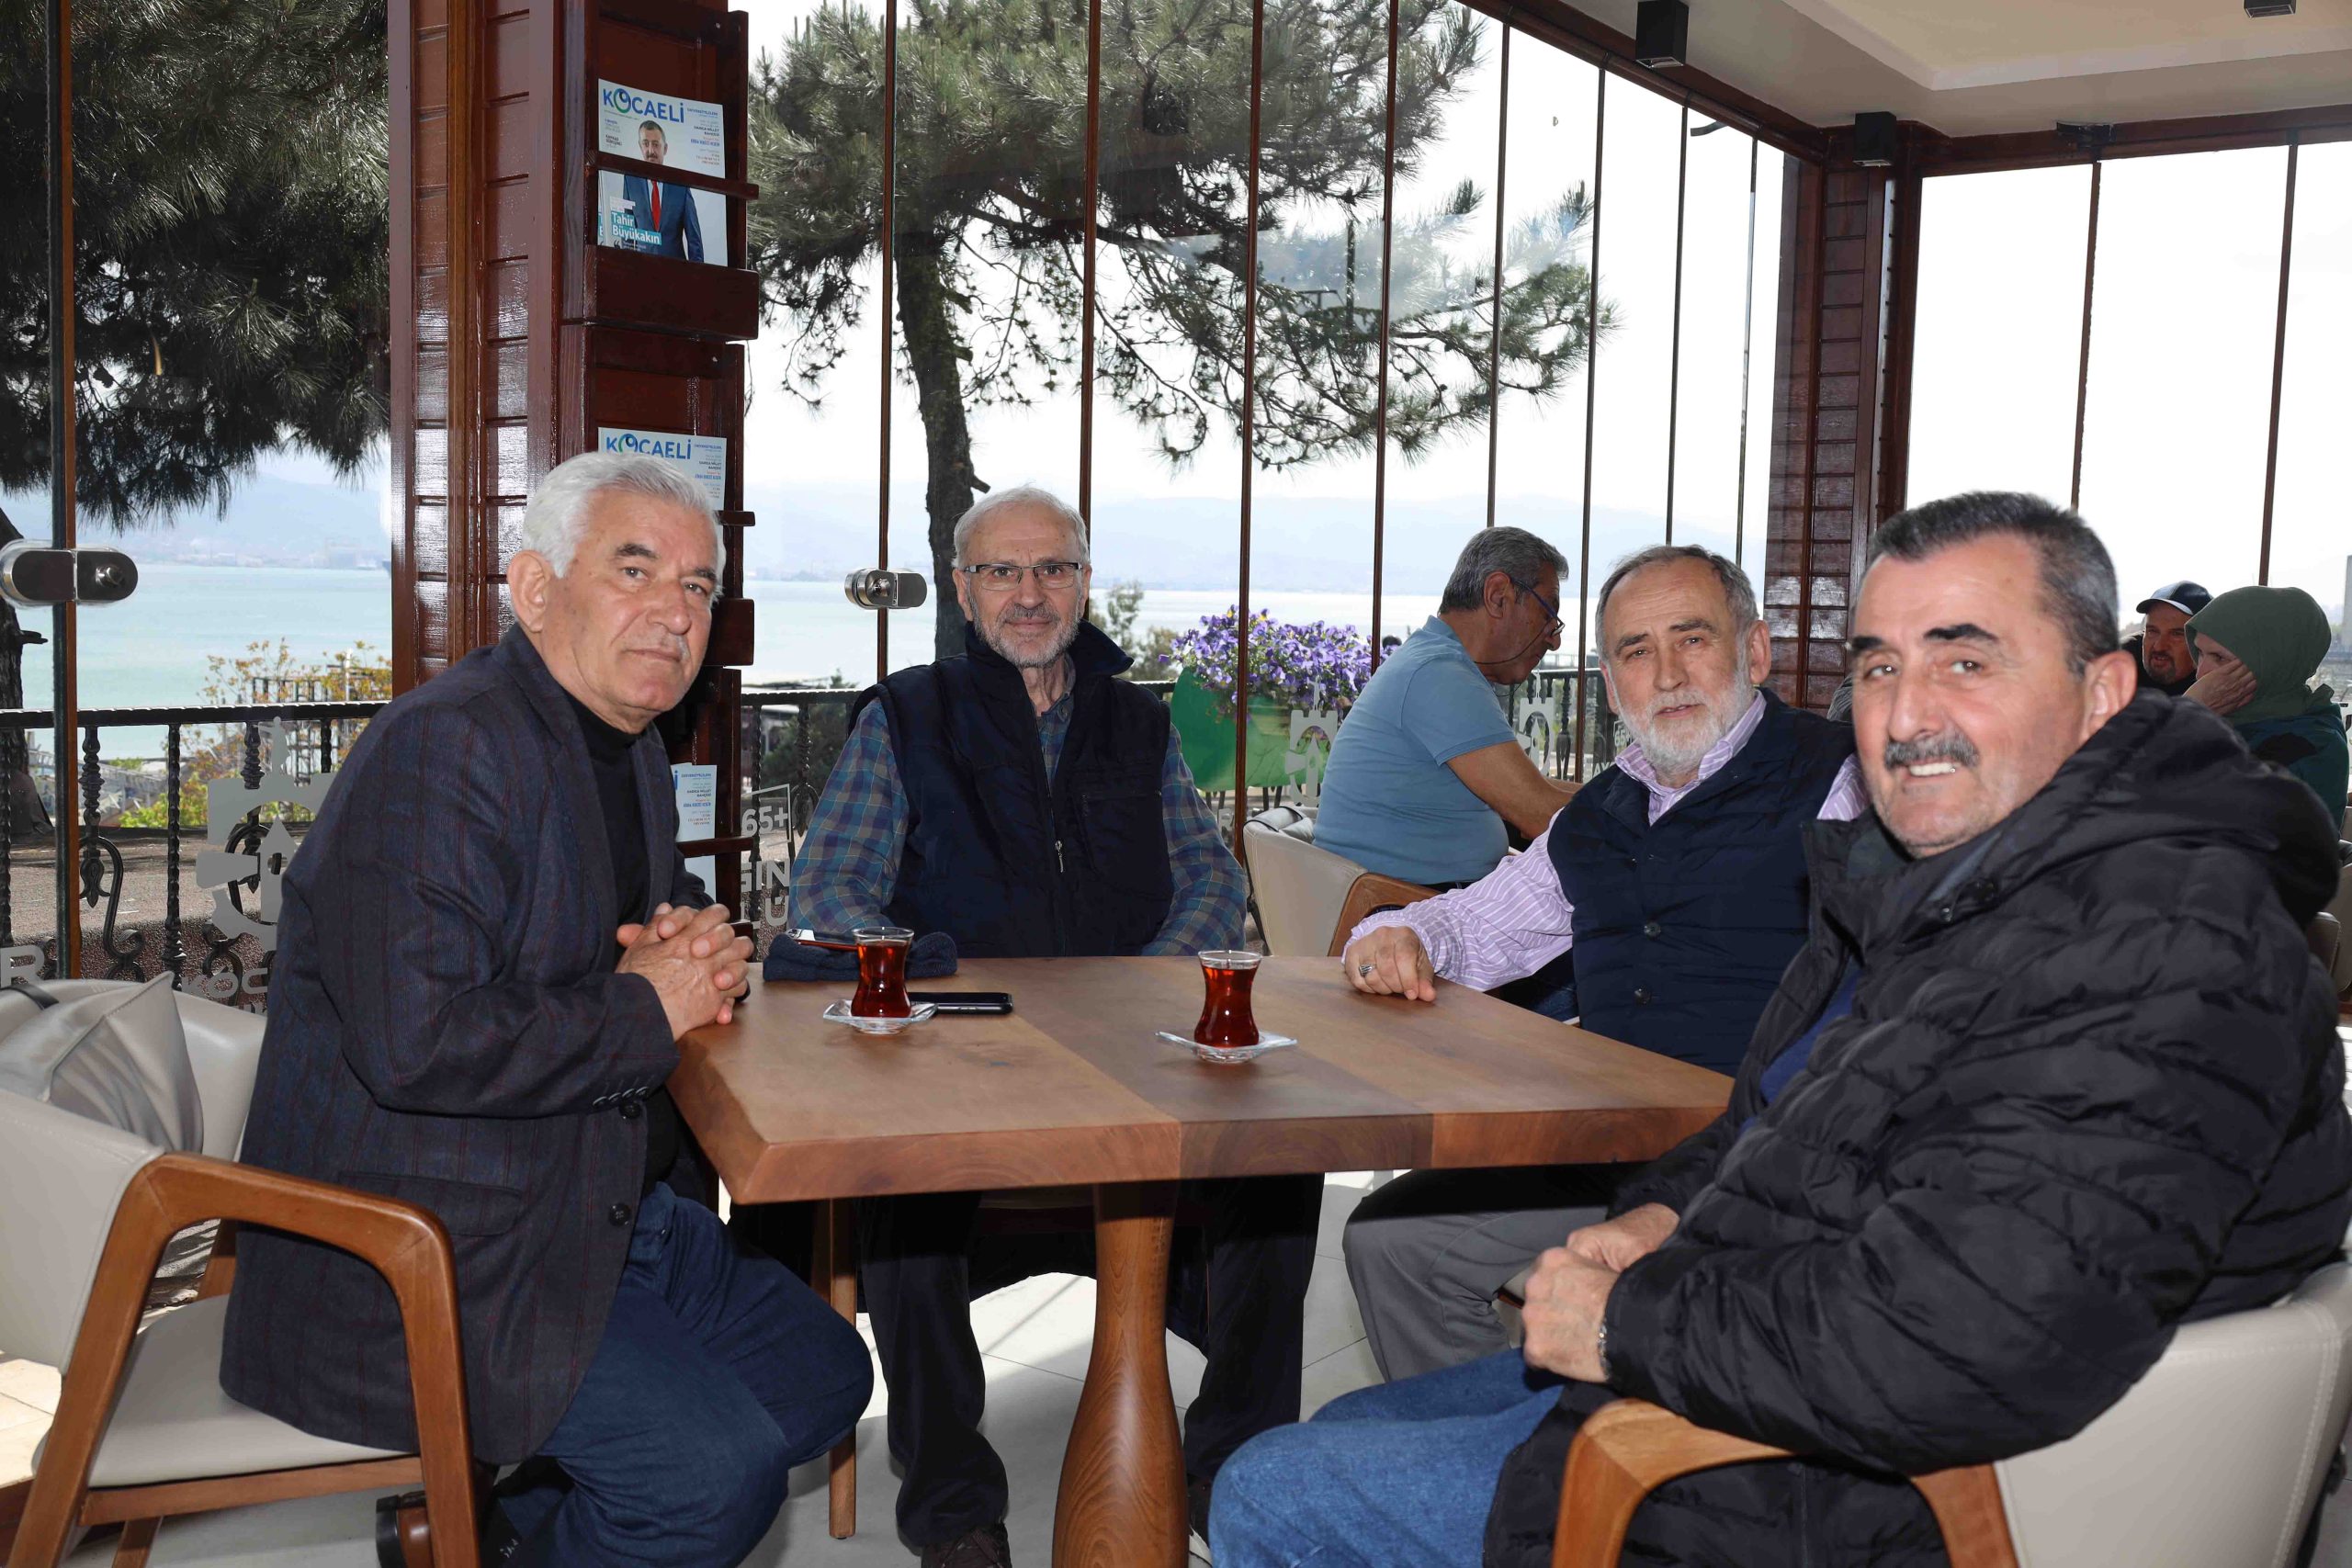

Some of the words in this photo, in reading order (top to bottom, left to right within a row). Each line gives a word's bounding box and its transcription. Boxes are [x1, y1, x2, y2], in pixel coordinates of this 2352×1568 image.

[603, 88, 684, 123] KOCAELİ
[612, 212, 634, 227] Tahir
[613, 225, 661, 244] Büyükakın
[741, 806, 788, 837] 65+
